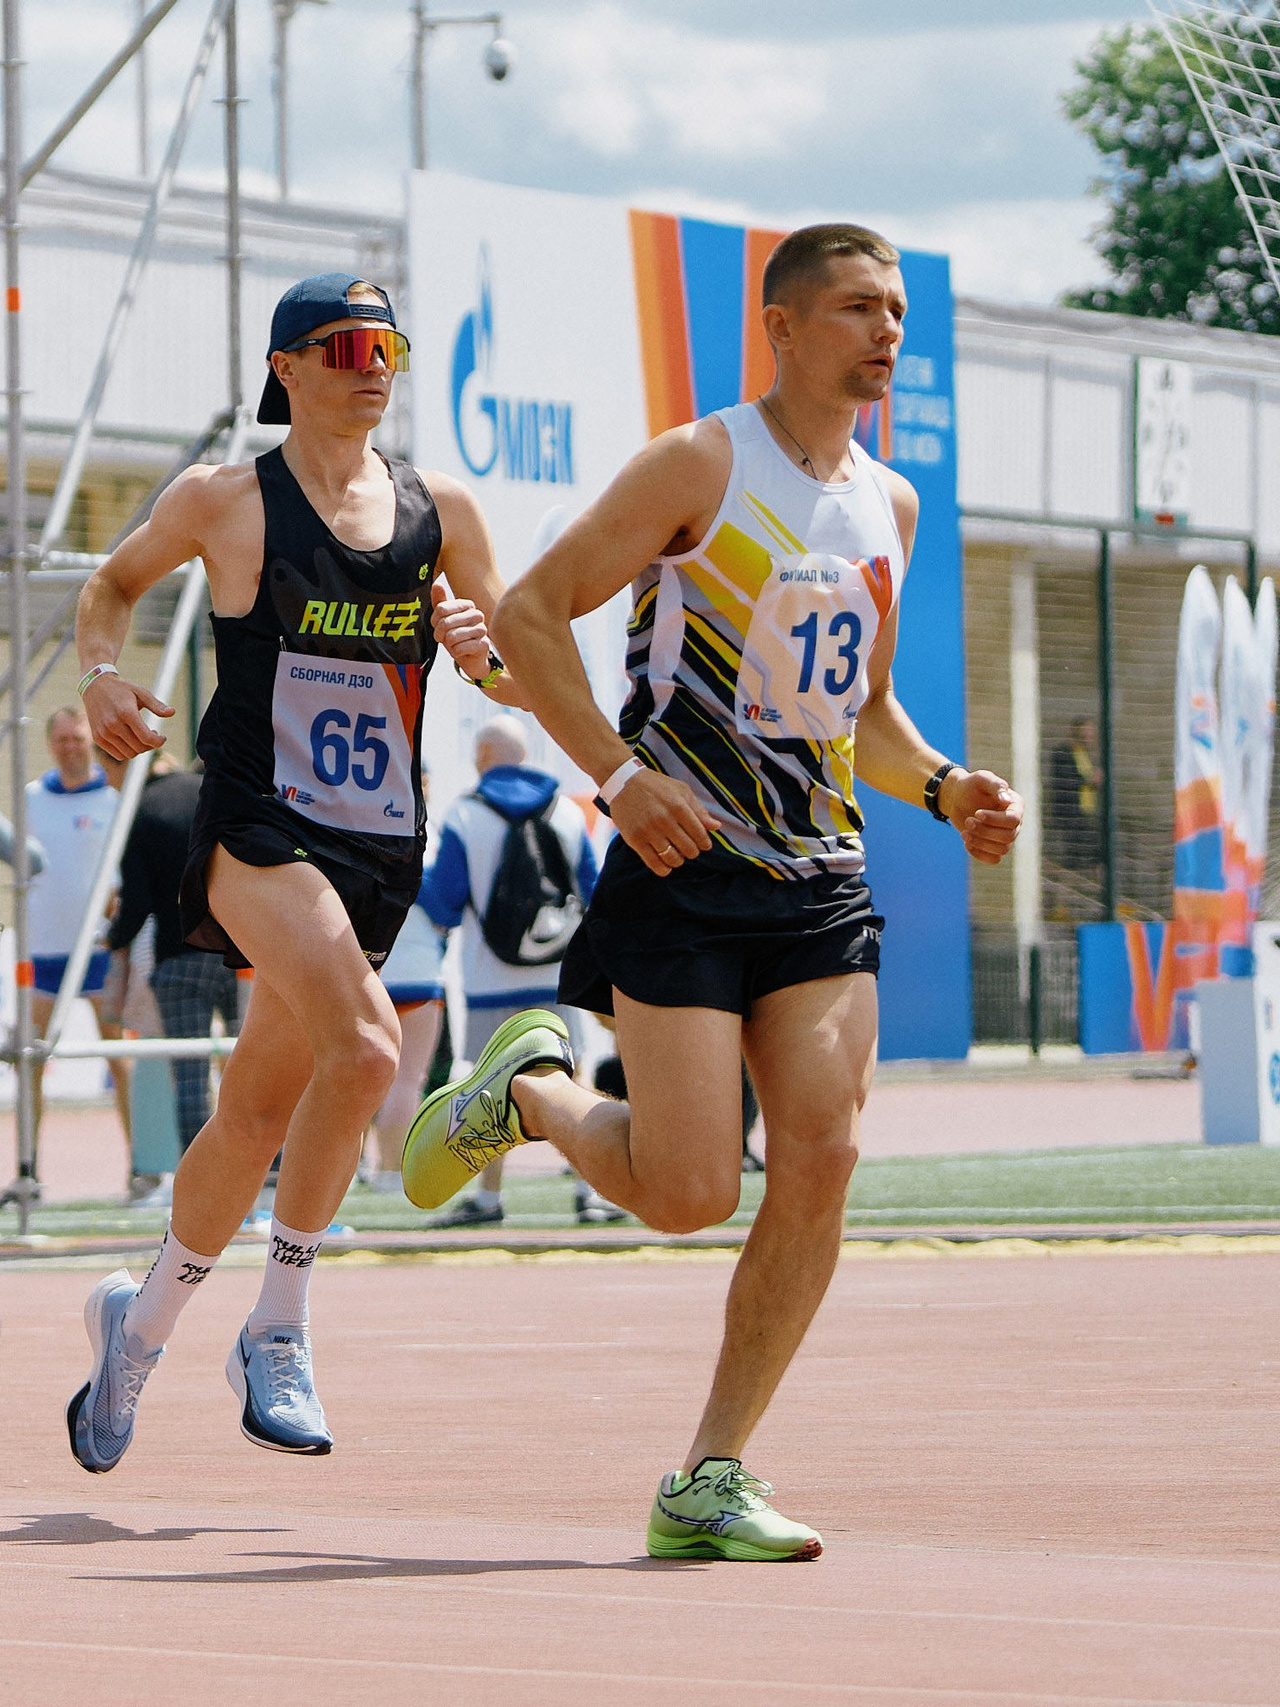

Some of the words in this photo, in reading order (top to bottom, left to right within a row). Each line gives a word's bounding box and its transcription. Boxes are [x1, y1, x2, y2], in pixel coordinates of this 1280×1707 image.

[820, 570, 840, 584] №3
[290, 666, 346, 685] СБОРНАЯ
[348, 674, 374, 689] ДЗО
[790, 610, 862, 696] 13
[309, 708, 390, 791] 65
